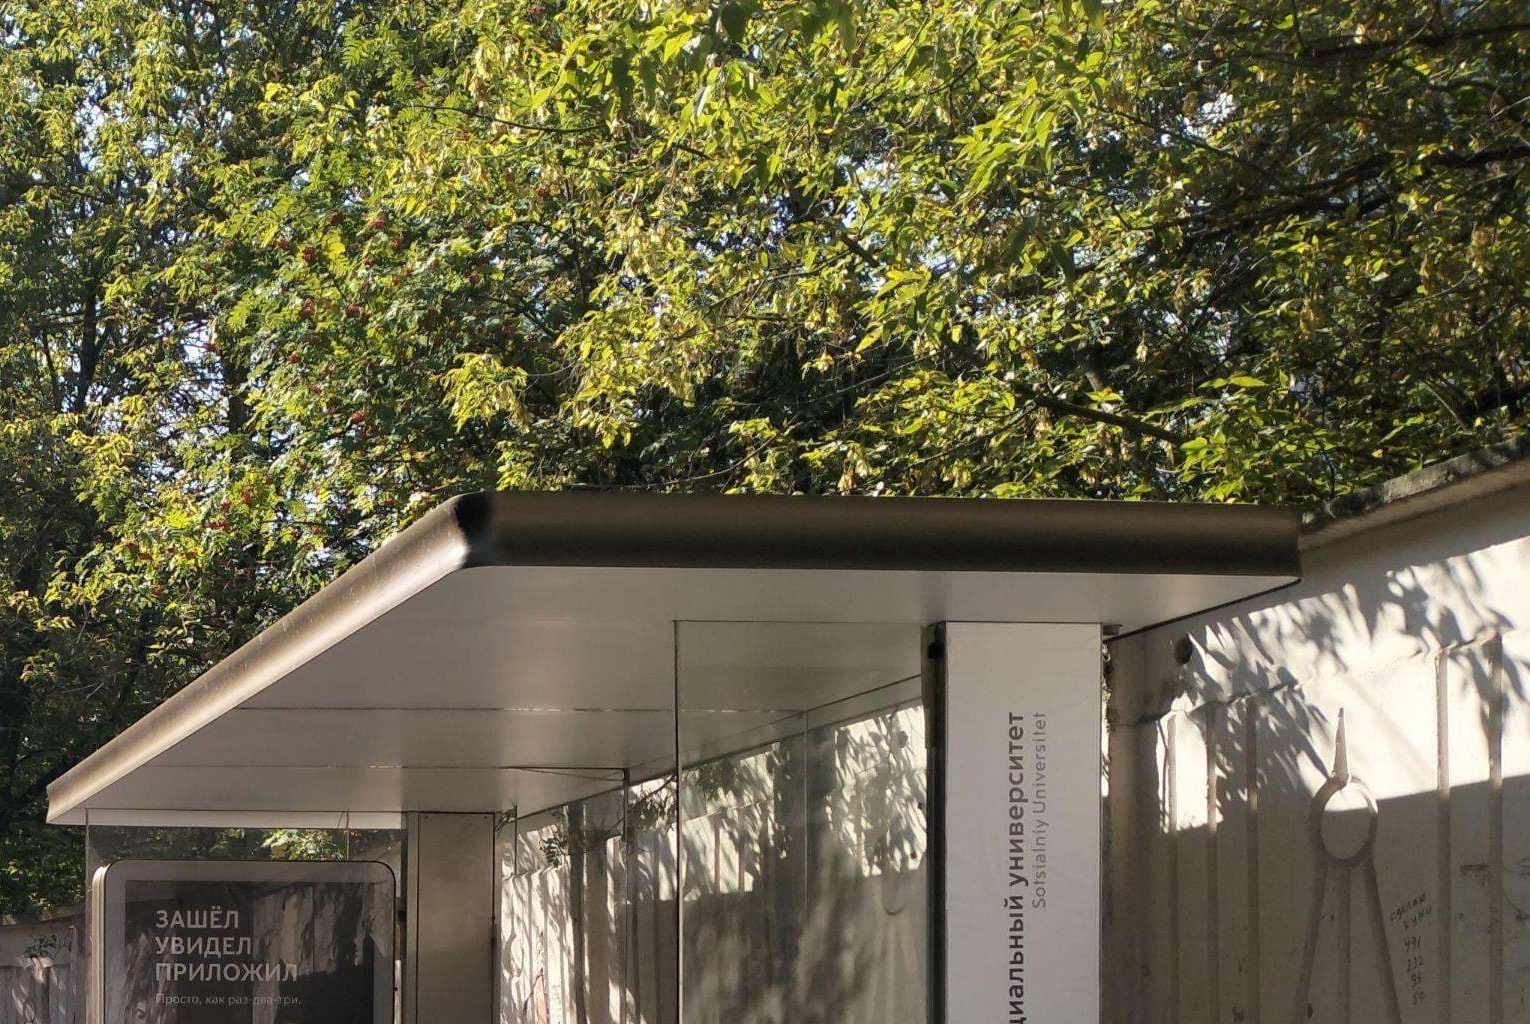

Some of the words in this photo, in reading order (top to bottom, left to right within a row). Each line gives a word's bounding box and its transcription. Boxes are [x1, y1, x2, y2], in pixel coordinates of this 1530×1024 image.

[1032, 712, 1046, 813] Universitet
[1008, 711, 1028, 887] университет
[1032, 819, 1049, 909] Sotsialniy
[155, 905, 239, 929] ЗАШЁЛ
[155, 936, 251, 958] УВИДЕЛ
[155, 963, 298, 982] ПРИЛОЖИЛ
[205, 996, 225, 1004] как
